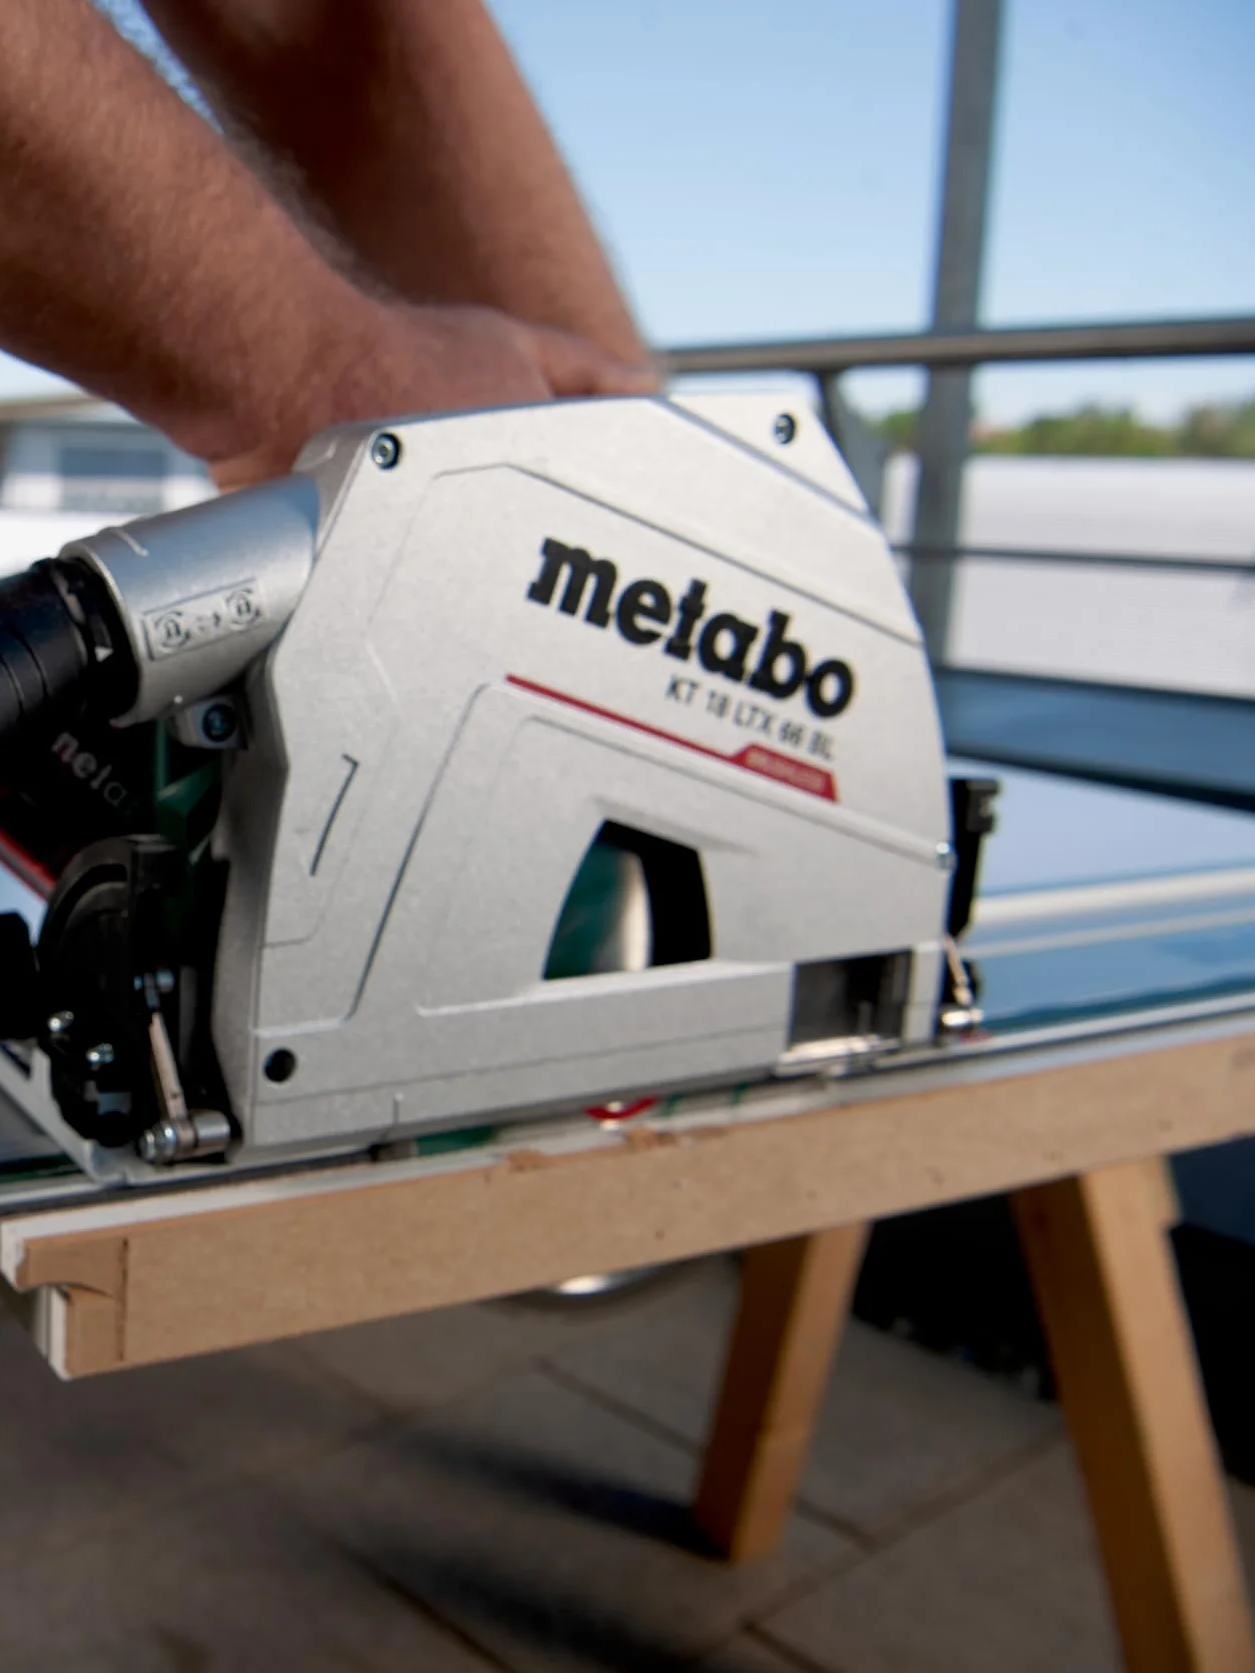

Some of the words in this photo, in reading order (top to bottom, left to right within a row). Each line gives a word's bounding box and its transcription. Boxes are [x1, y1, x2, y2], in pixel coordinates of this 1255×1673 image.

[527, 537, 856, 718] metabo
[665, 674, 699, 705] KT
[706, 690, 730, 719] 18
[733, 701, 775, 736] LTX
[51, 732, 131, 808] meta
